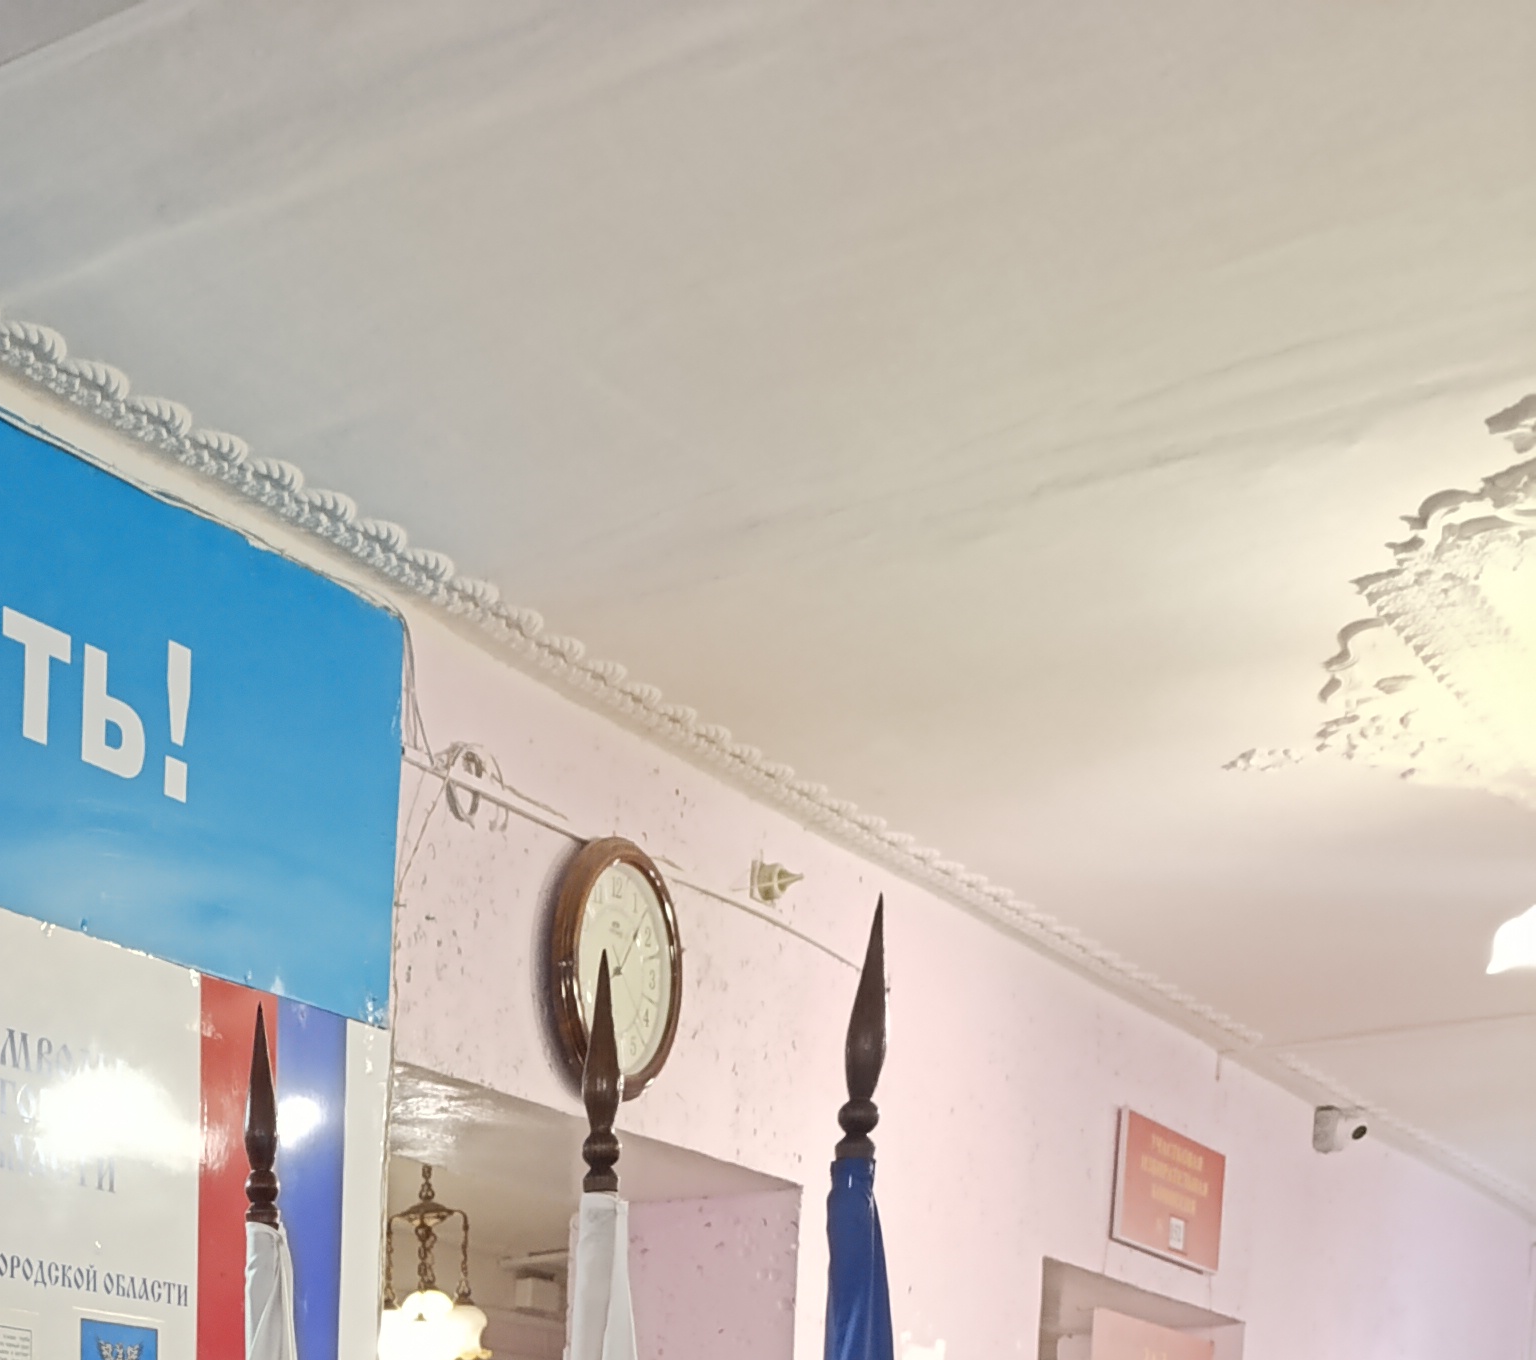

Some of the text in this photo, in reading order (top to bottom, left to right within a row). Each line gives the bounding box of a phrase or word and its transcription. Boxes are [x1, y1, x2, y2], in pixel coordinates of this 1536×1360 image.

[644, 929, 652, 947] 2
[649, 969, 656, 989] 3
[643, 1009, 650, 1027] 4
[103, 1271, 189, 1307] ОБЛАСТИ
